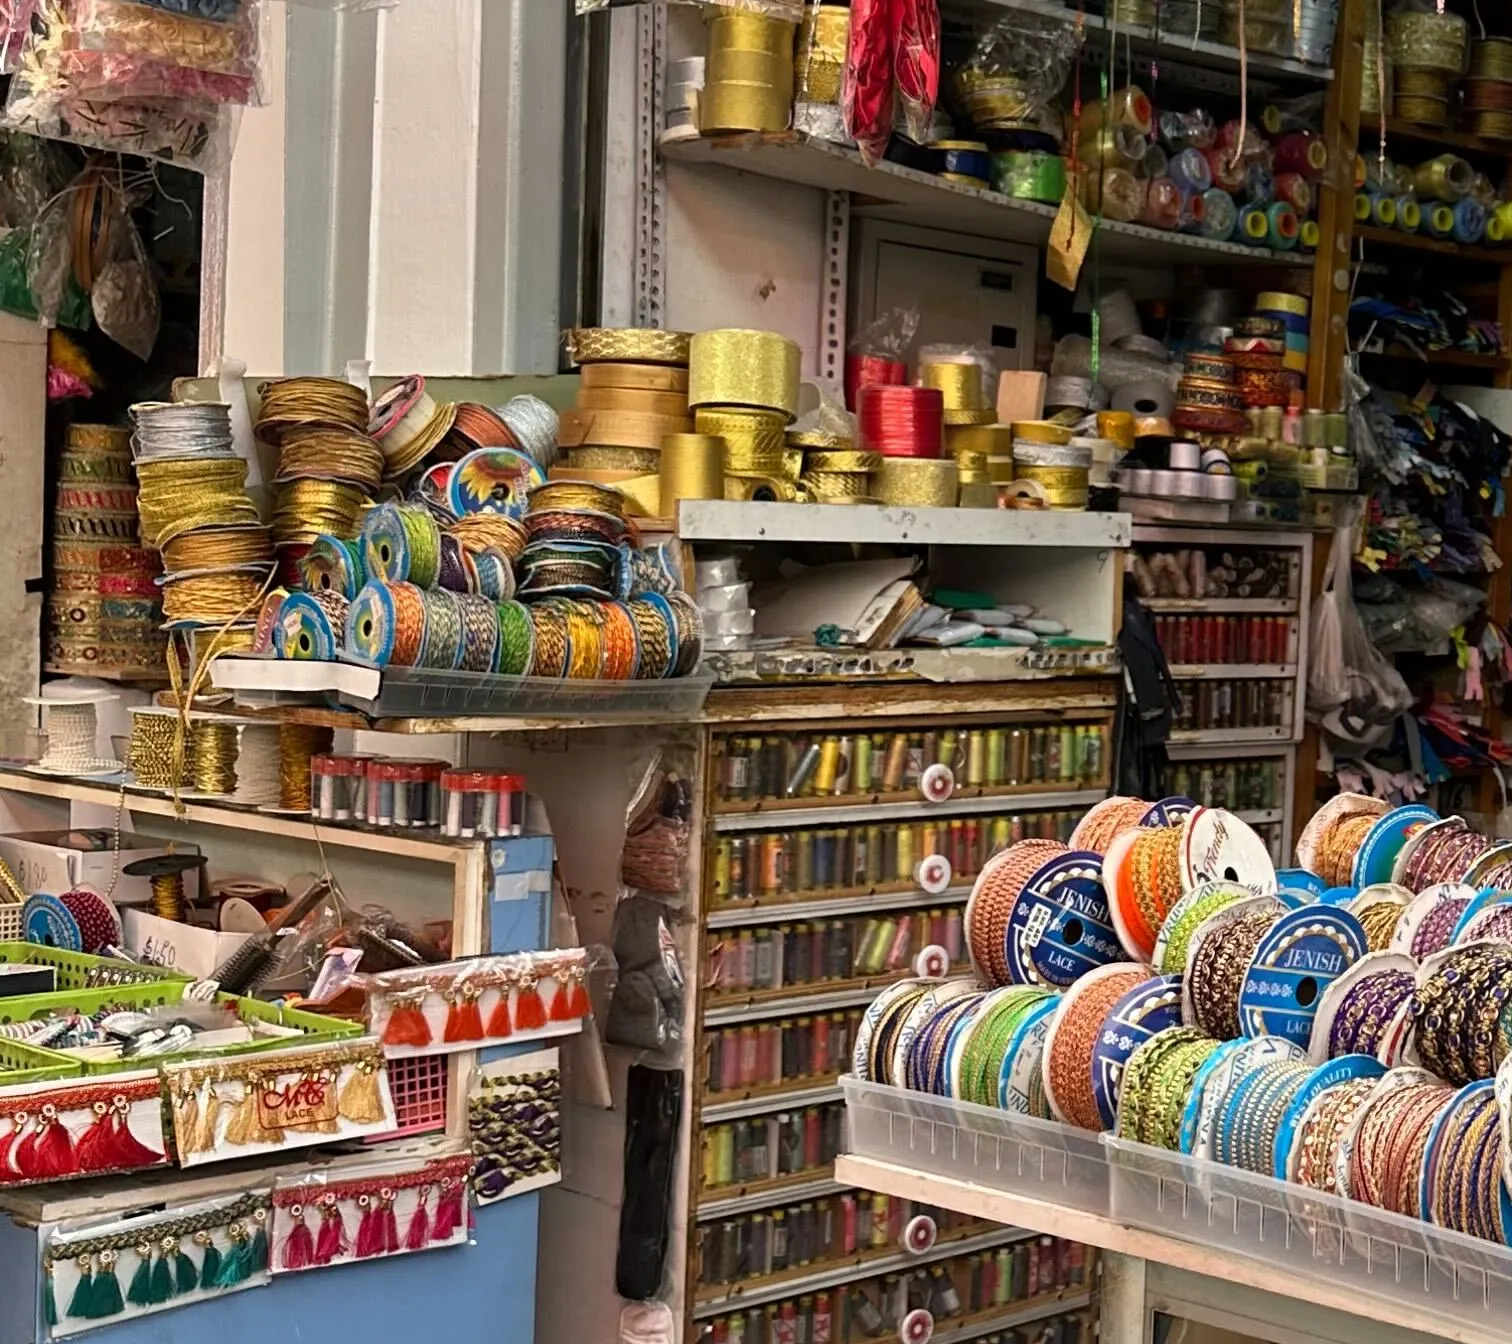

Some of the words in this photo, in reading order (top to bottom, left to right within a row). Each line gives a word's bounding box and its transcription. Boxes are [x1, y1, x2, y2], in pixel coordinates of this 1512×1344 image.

[1203, 819, 1229, 876] Trendy
[1048, 951, 1075, 972] LACE
[1284, 948, 1343, 973] JENISH
[1311, 1066, 1353, 1094] QUALITY
[285, 1107, 316, 1120] LACE
